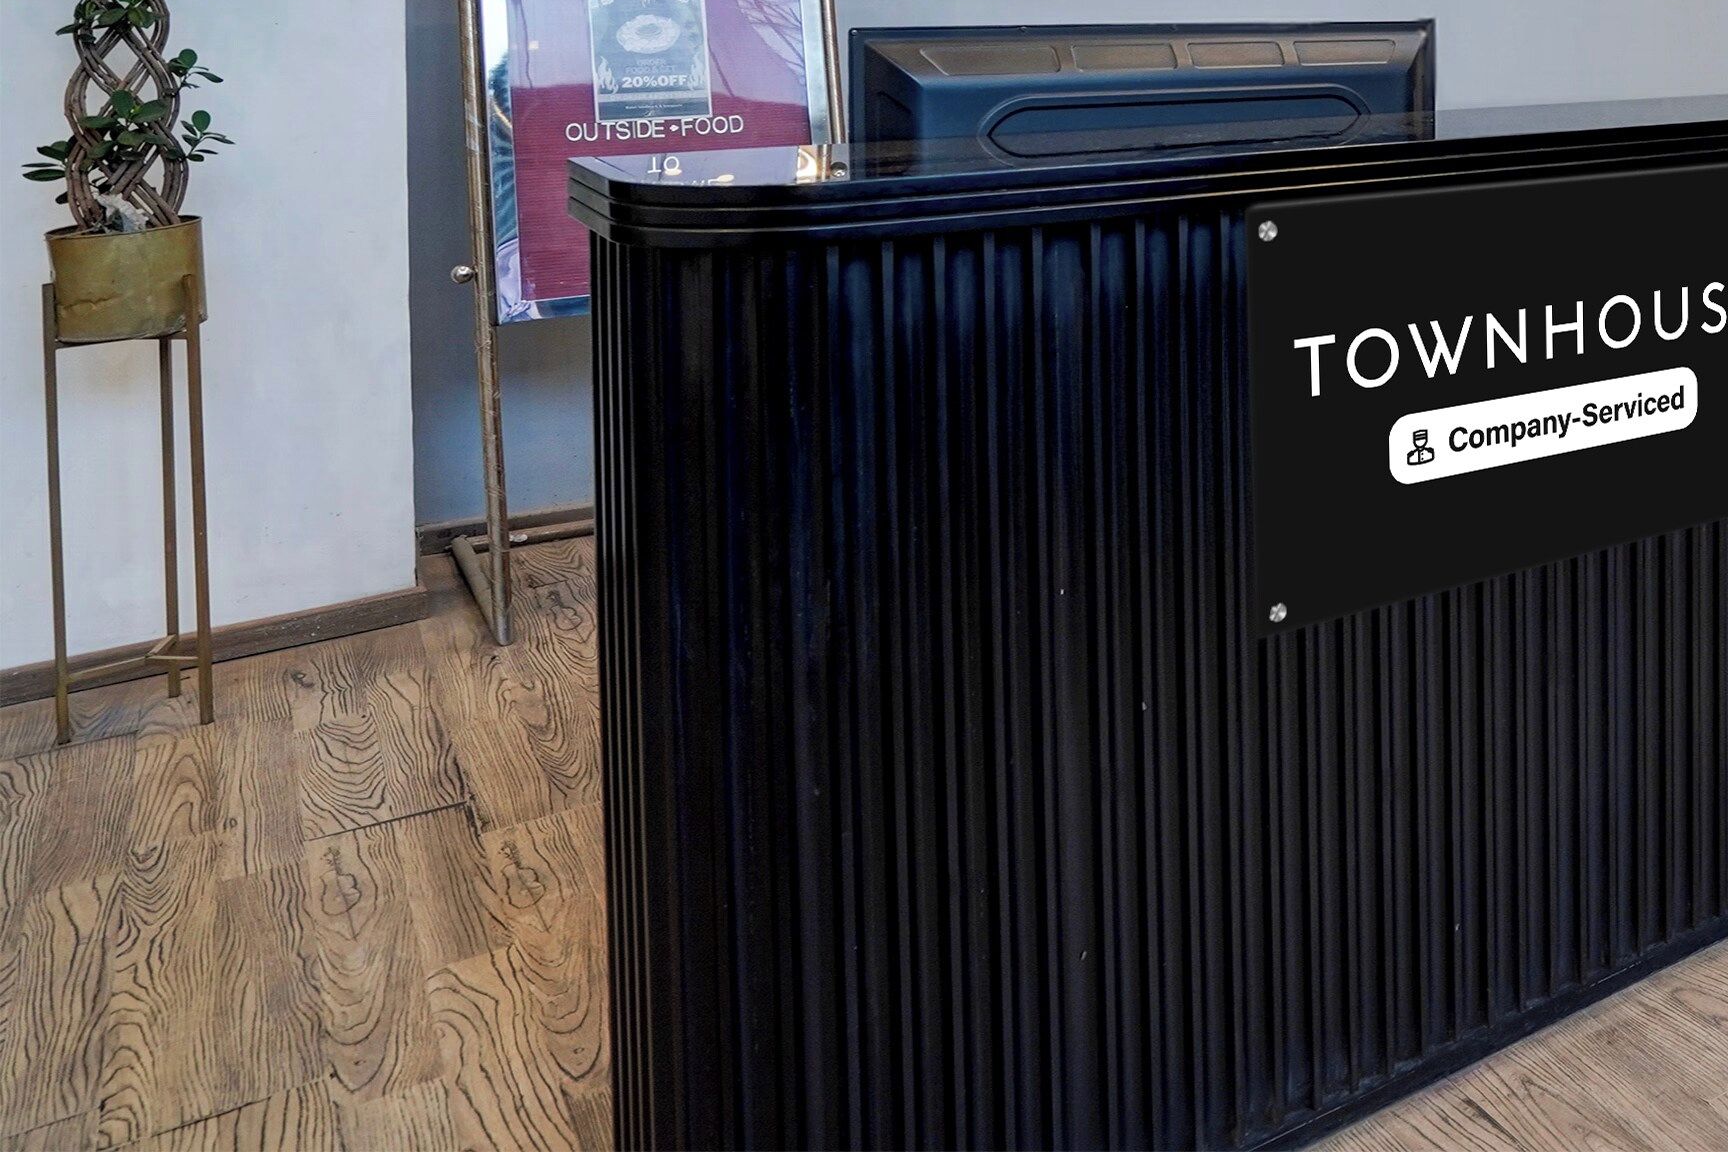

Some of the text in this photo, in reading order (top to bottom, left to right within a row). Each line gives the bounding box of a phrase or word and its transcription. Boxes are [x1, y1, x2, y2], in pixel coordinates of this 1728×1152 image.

[565, 114, 745, 142] OUTSIDE FOOD
[1448, 384, 1685, 453] Company-Serviced
